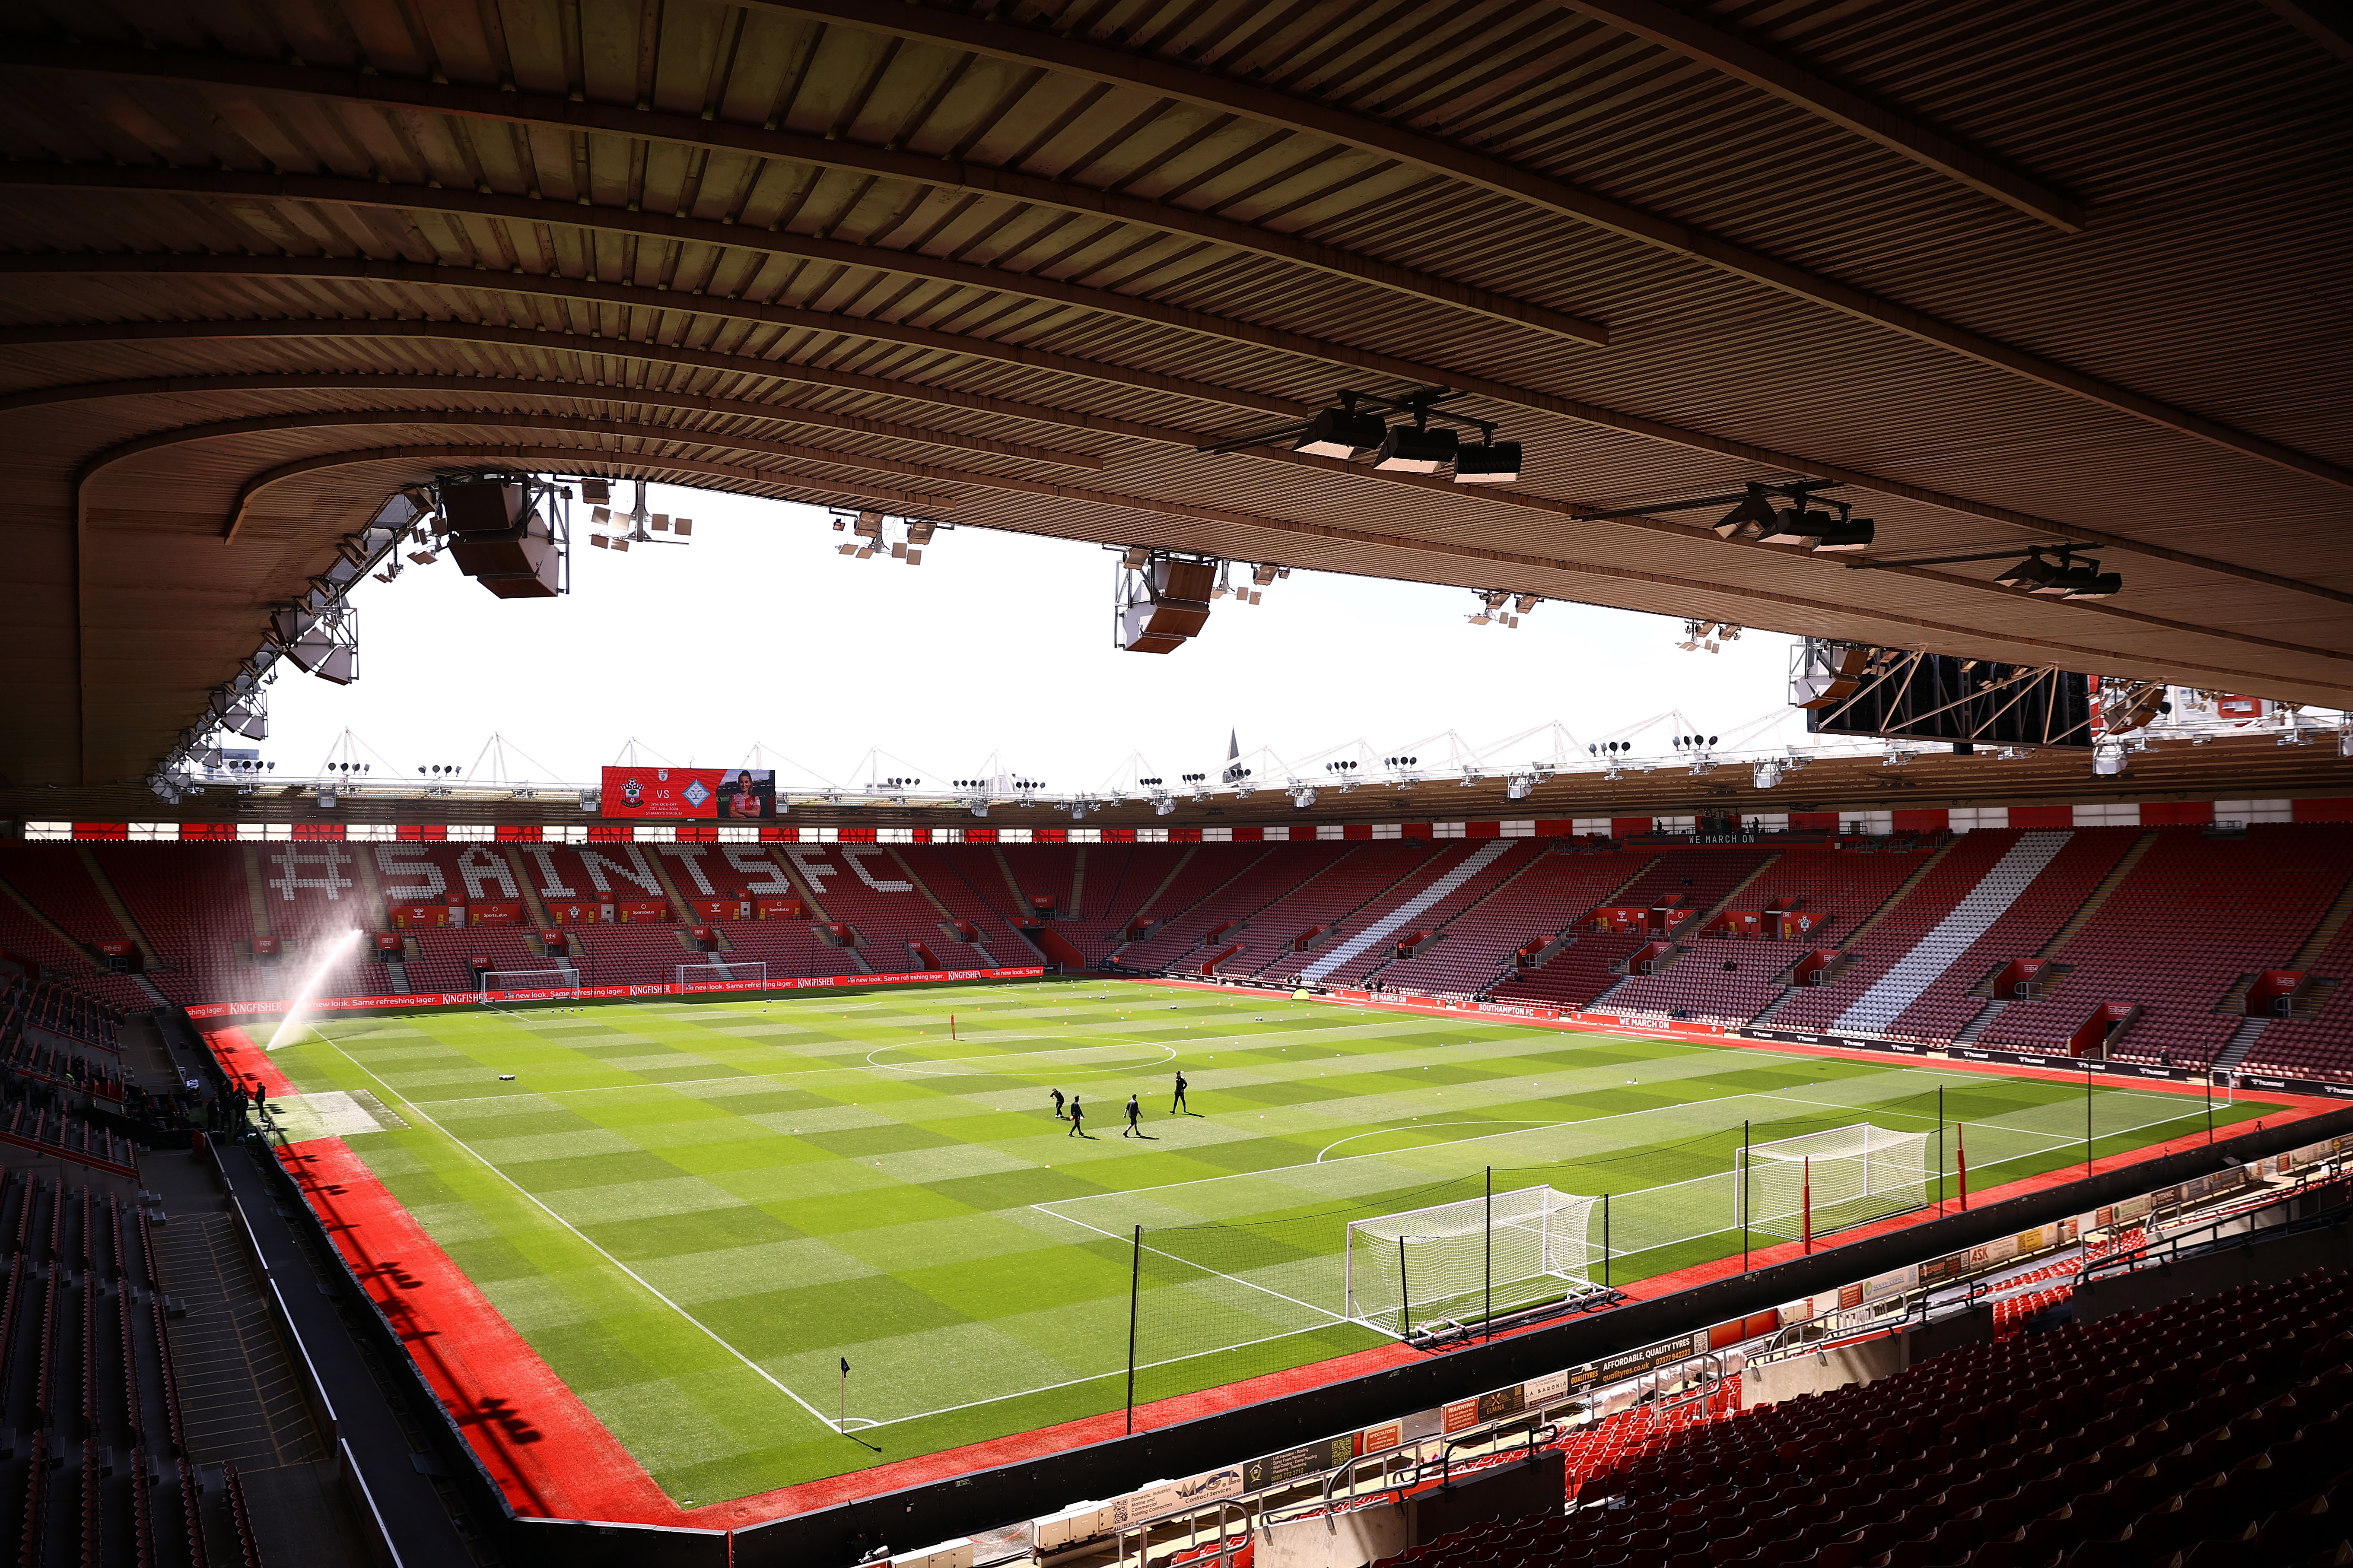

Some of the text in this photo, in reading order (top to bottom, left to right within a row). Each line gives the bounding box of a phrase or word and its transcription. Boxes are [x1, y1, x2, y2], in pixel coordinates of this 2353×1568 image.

[657, 790, 669, 798] VS
[1689, 835, 1754, 844] WE MARCH ON
[948, 971, 981, 981] KINGFISHER
[230, 1002, 282, 1015] KINGFISHER
[1479, 1003, 1524, 1015] SOUTHAMPTON
[1619, 1017, 1669, 1029] WE MARCH ON
[2260, 1079, 2285, 1088] hummel
[1971, 1247, 1988, 1263] ASK
[1603, 1338, 1690, 1371] AFFORDABLE, QUALITY TYRES
[1603, 1362, 1650, 1383] qualityres.co.uk
[1656, 1355, 1671, 1365] 07377
[1672, 1348, 1691, 1360] 942223
[1571, 1370, 1599, 1385] QUALITYRES
[1538, 1381, 1567, 1393] BARONIA
[1448, 1401, 1475, 1414] WARNING
[1487, 1404, 1505, 1414] ELMINA
[1369, 1428, 1396, 1439] SPECTATORS
[1293, 1468, 1304, 1476] 3712
[1131, 1487, 1171, 1502] Domestic, Industrial
[1185, 1495, 1208, 1504] Contract
[1210, 1487, 1231, 1497] Services
[1131, 1502, 1157, 1512] Commercial
[1131, 1502, 1173, 1517] Painting Contractors
[1109, 1522, 1135, 1533] CALL/TEXT:
